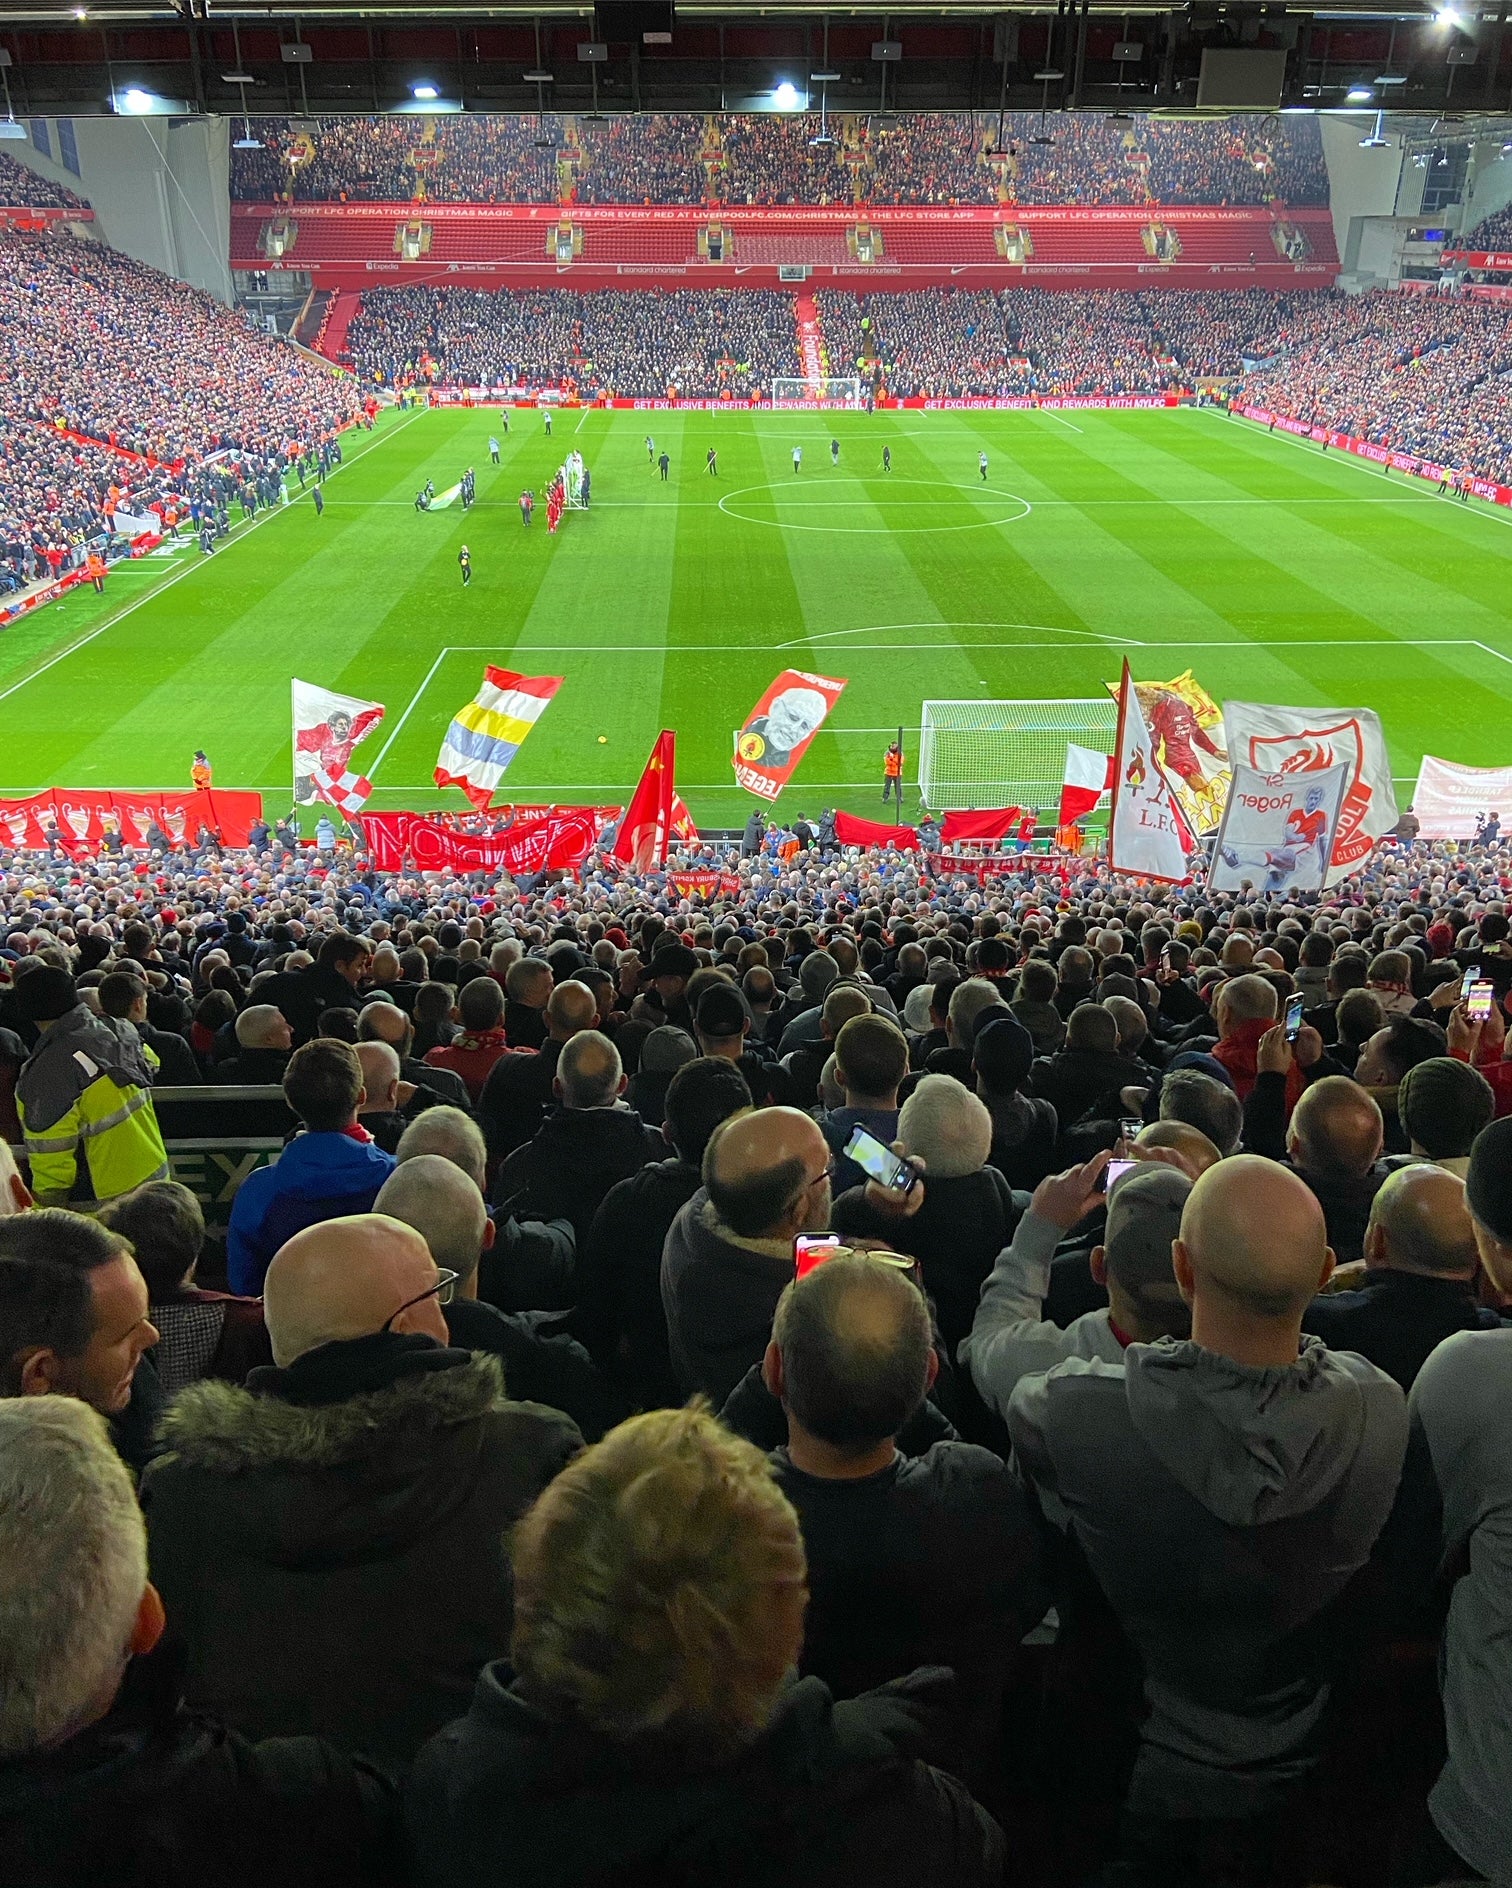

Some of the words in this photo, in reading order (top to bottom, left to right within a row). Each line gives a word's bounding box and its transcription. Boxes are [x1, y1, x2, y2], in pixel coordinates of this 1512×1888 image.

[347, 208, 410, 216] OPERATION
[412, 209, 476, 217] CHRISTMAS
[477, 209, 513, 217] MAGIC
[693, 211, 859, 219] LIVERPOOLFC.COM/CHRISTMAS
[1218, 211, 1253, 219] MAGIC
[373, 263, 399, 271] Expedia
[623, 266, 653, 274] standard
[654, 266, 686, 274] chartered
[634, 400, 652, 409] GET
[706, 400, 749, 409] BENEFITS
[924, 400, 942, 409] GET
[945, 400, 994, 409] EXCLUSIVE
[996, 400, 1032, 409] BENEFIT
[1041, 400, 1060, 409] AND
[1062, 399, 1107, 409] REWARDS
[1108, 399, 1132, 409] WITH
[1134, 399, 1165, 409] MYLFC
[1336, 845, 1364, 862] CLUB
